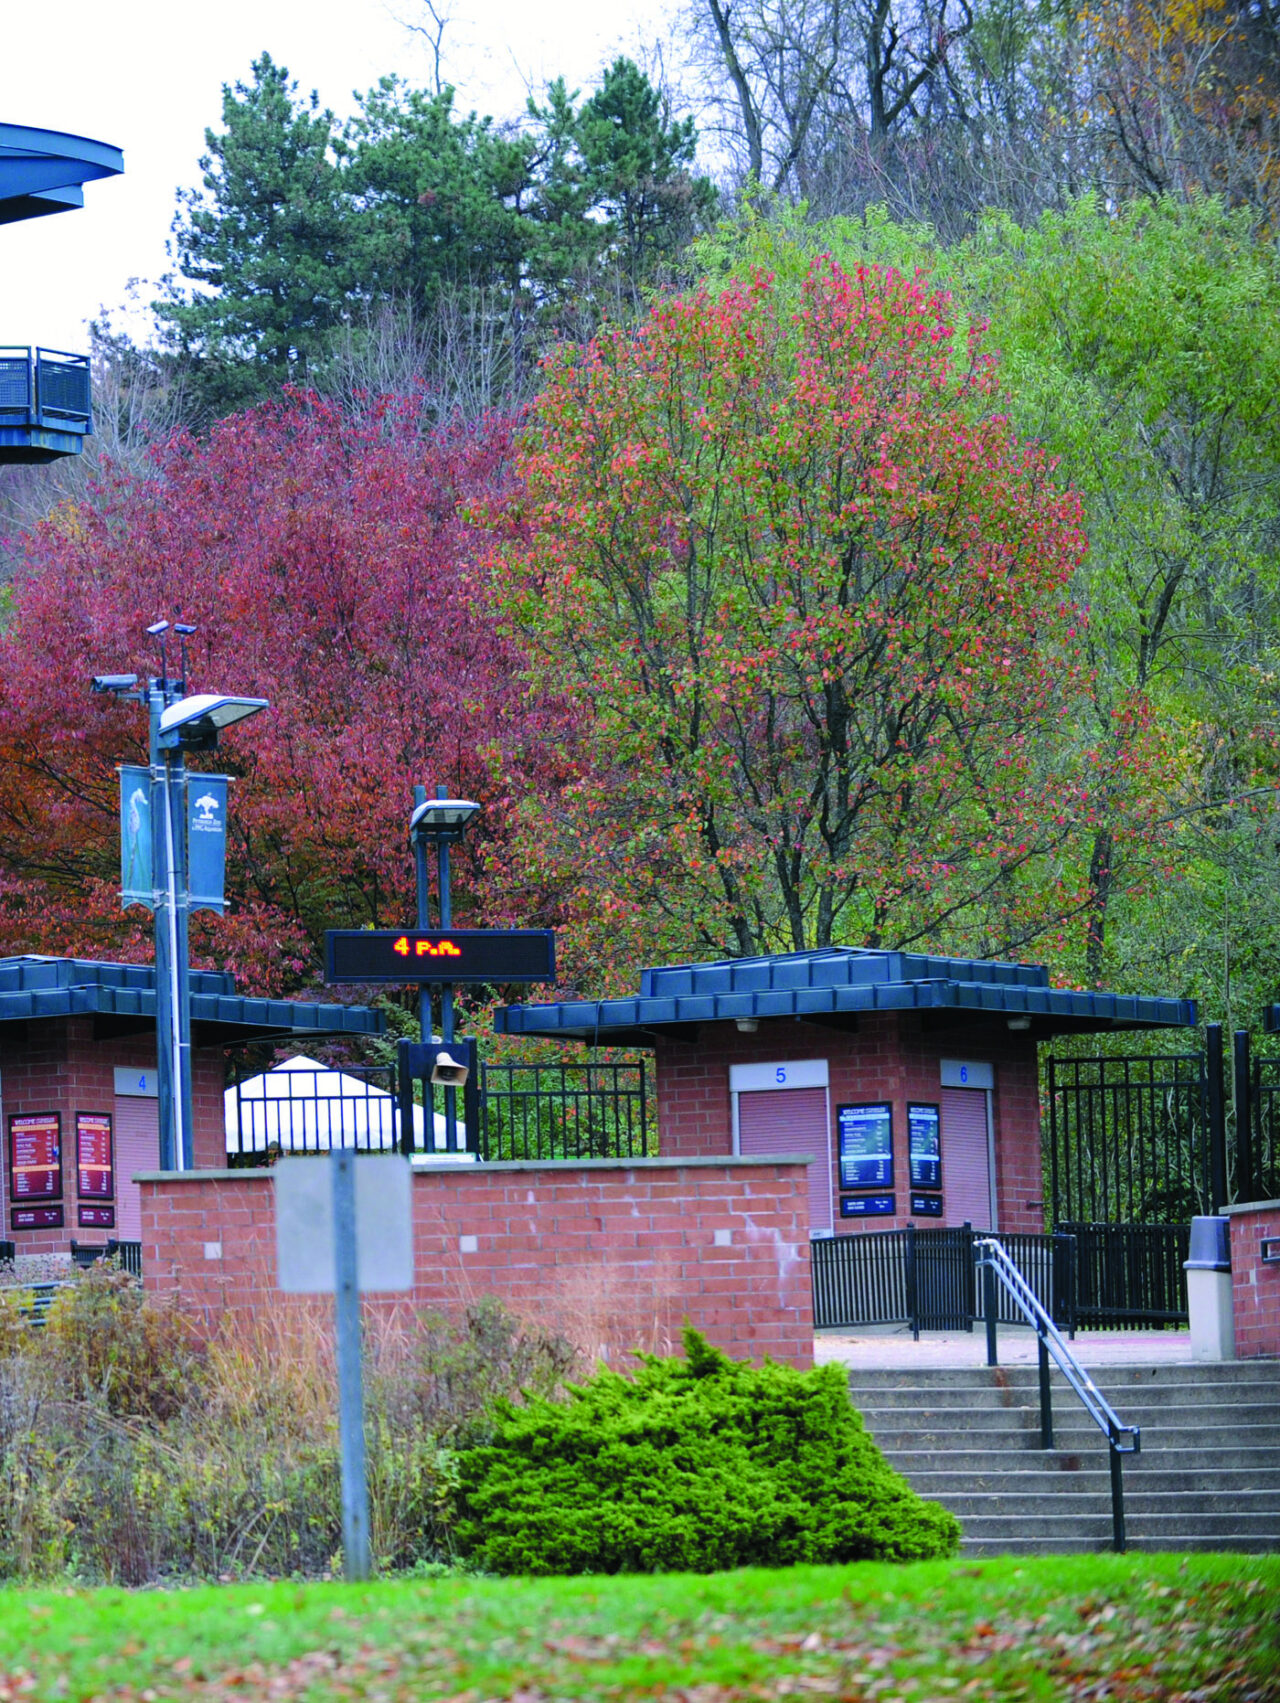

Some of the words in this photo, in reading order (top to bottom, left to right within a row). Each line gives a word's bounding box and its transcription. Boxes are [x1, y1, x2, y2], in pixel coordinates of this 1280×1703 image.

[393, 936, 410, 956] 4
[776, 1067, 787, 1083] 5
[960, 1066, 968, 1083] 6
[138, 1075, 147, 1091] 4
